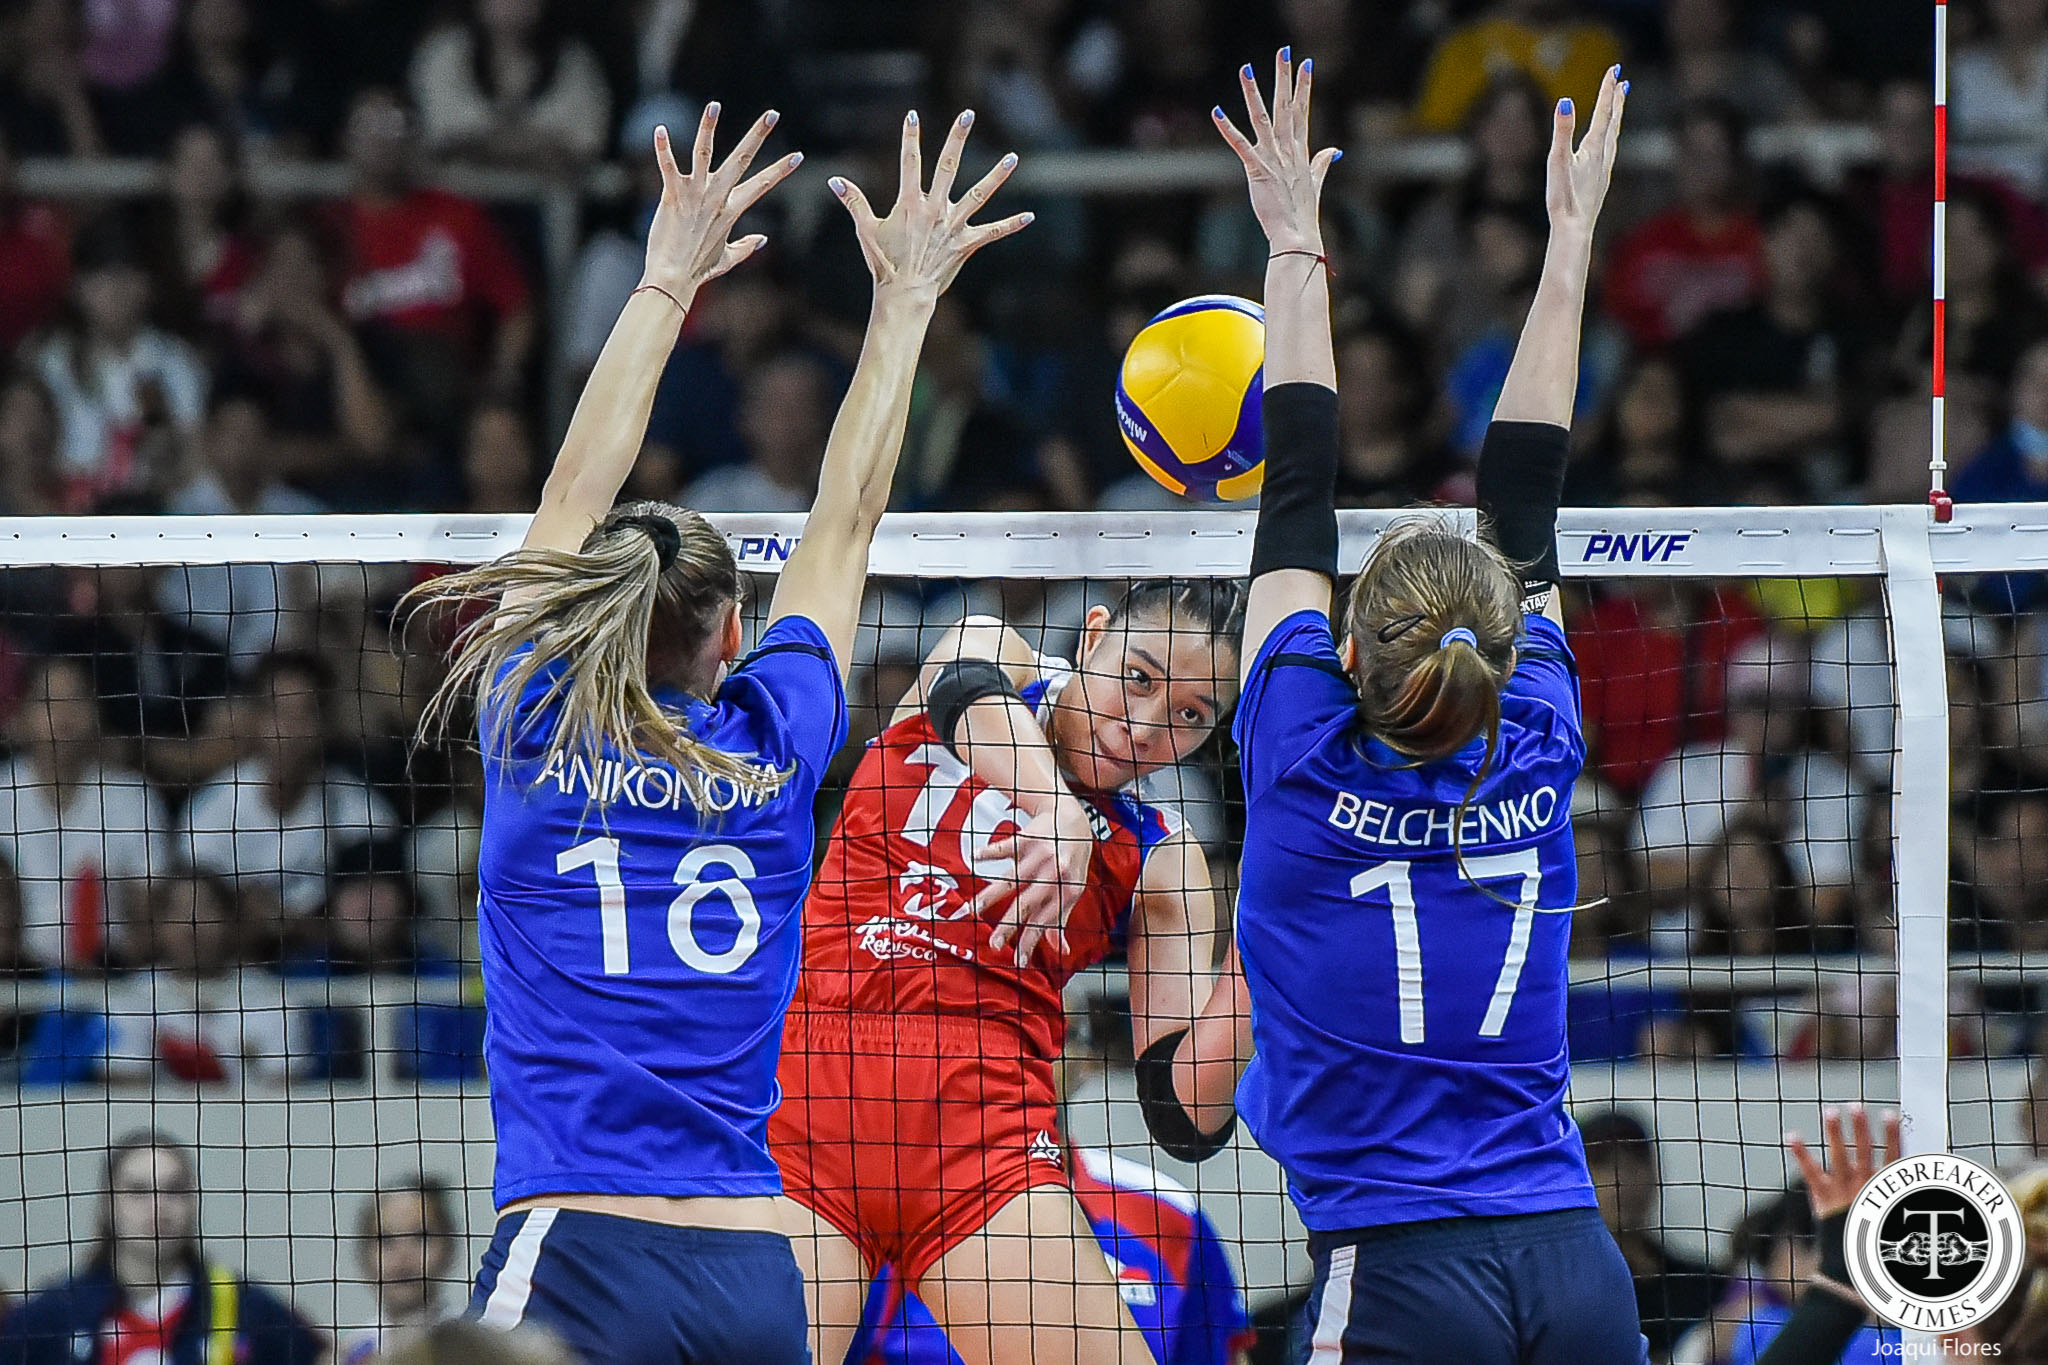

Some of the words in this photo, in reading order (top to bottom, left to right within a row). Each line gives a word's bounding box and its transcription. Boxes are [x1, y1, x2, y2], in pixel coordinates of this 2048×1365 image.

[1115, 391, 1148, 442] Mika
[738, 538, 801, 561] PN
[1582, 534, 1691, 562] PNVF
[1519, 594, 1549, 612] KTAP
[535, 749, 780, 811] ANIKONOVA
[1328, 786, 1557, 846] BELCHENKO
[556, 837, 761, 974] 18
[1350, 847, 1542, 1044] 17
